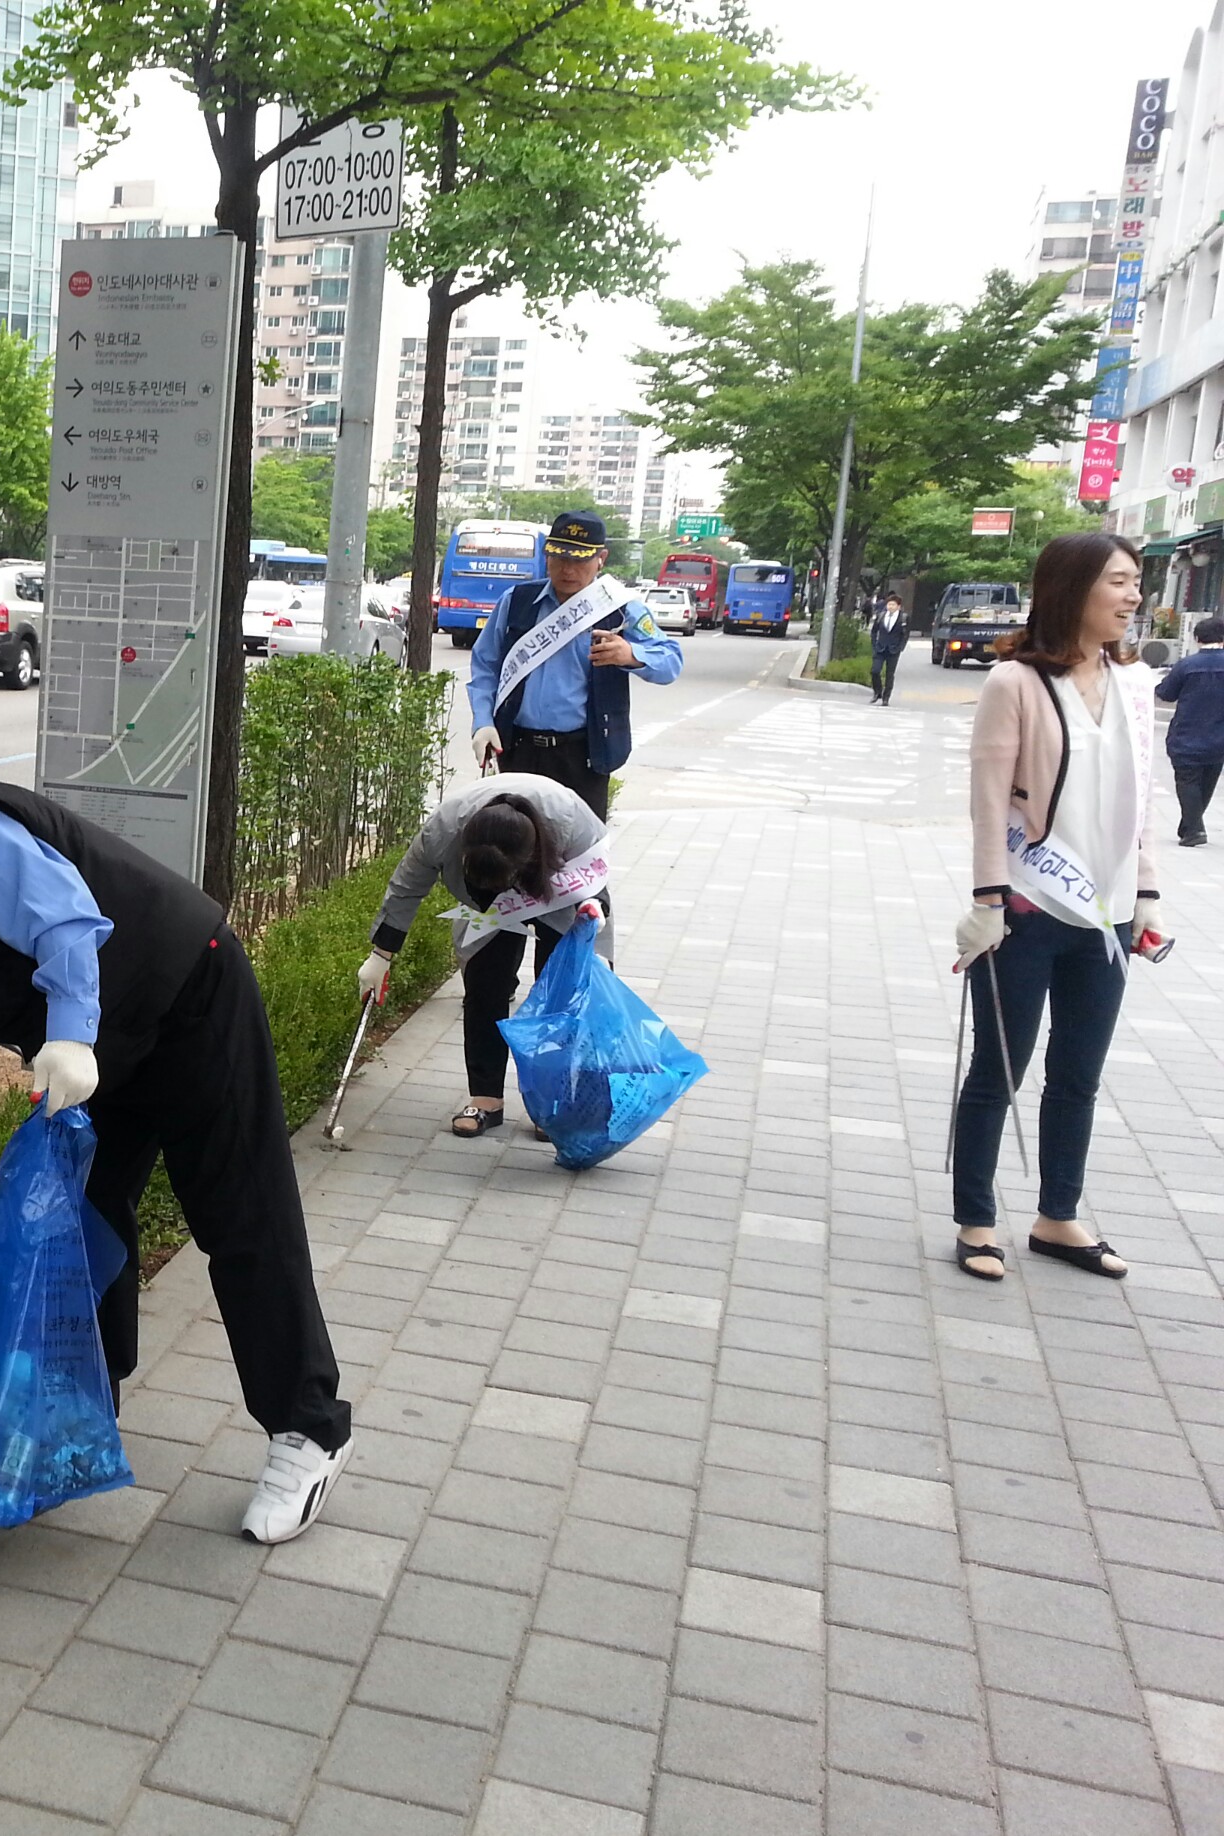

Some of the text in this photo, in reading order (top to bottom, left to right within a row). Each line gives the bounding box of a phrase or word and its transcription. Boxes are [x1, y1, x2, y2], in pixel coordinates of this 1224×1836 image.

[1136, 79, 1162, 151] COCO
[284, 149, 395, 190] 07:00~10:00
[284, 186, 393, 226] 17:00~21:00
[1122, 176, 1149, 239] 노래방
[97, 272, 200, 292] 인도네시아대사관
[98, 293, 139, 302] Indonesian
[93, 332, 142, 347] 원효대교
[91, 380, 187, 397] 여의도동주민센터
[88, 428, 160, 444] 여의도우체국
[86, 474, 122, 491] 대방역
[1171, 467, 1196, 488] 약
[523, 598, 594, 664] 음식물쓰레기를
